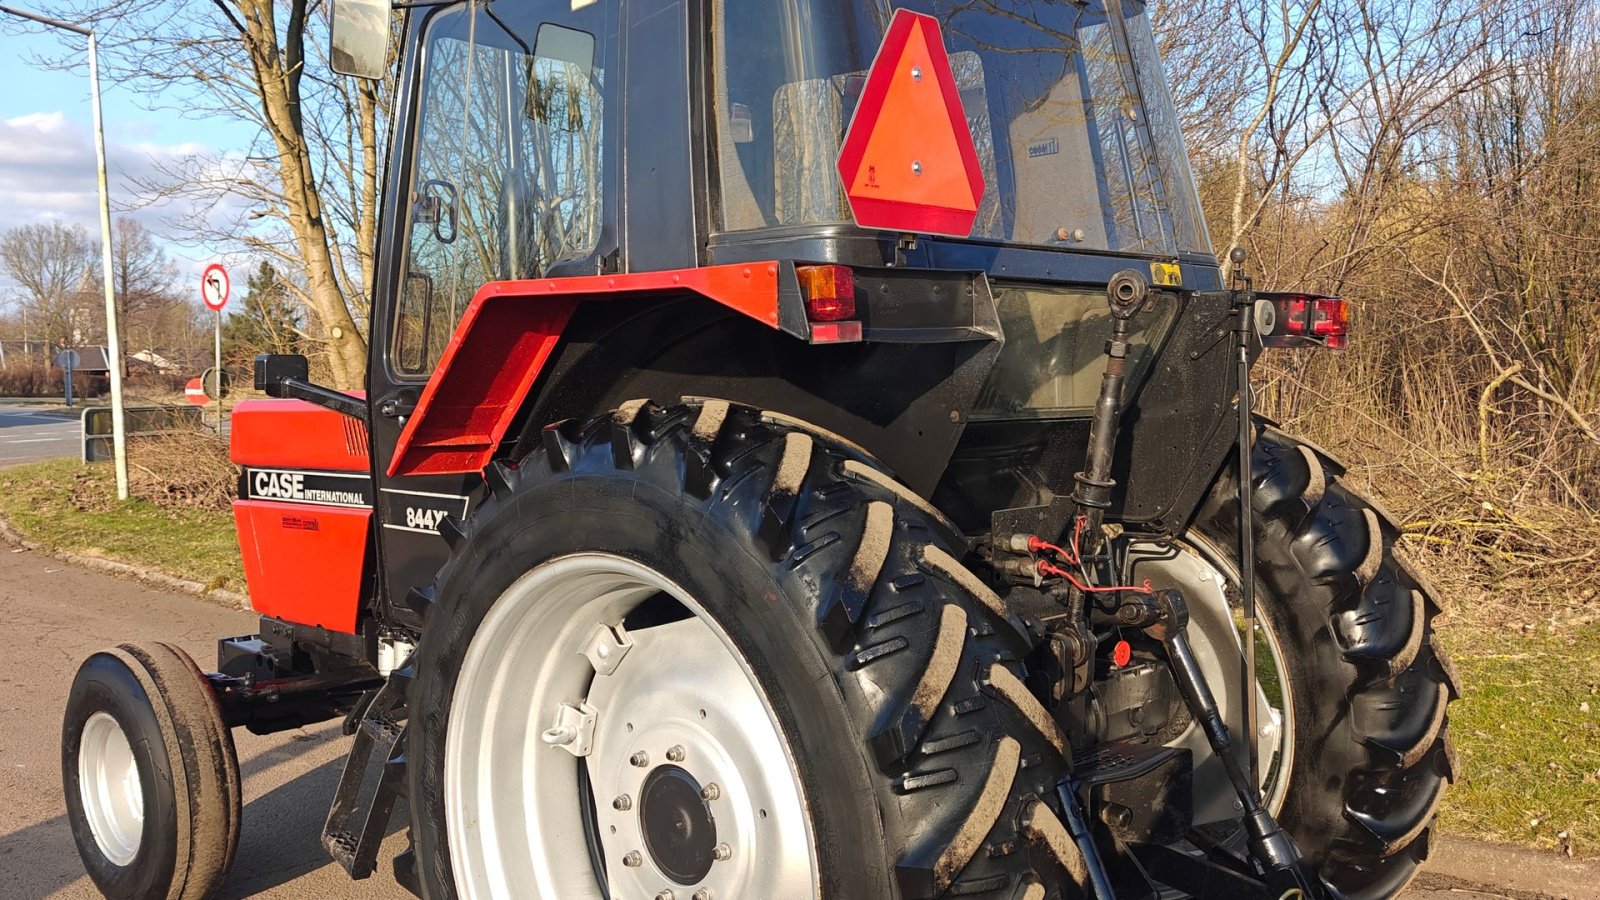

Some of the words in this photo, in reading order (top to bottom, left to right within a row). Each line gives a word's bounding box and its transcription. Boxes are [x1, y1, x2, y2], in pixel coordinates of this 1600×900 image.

[255, 472, 304, 499] CASE
[304, 489, 365, 505] INTERNATIONAL
[406, 507, 449, 531] 844X
